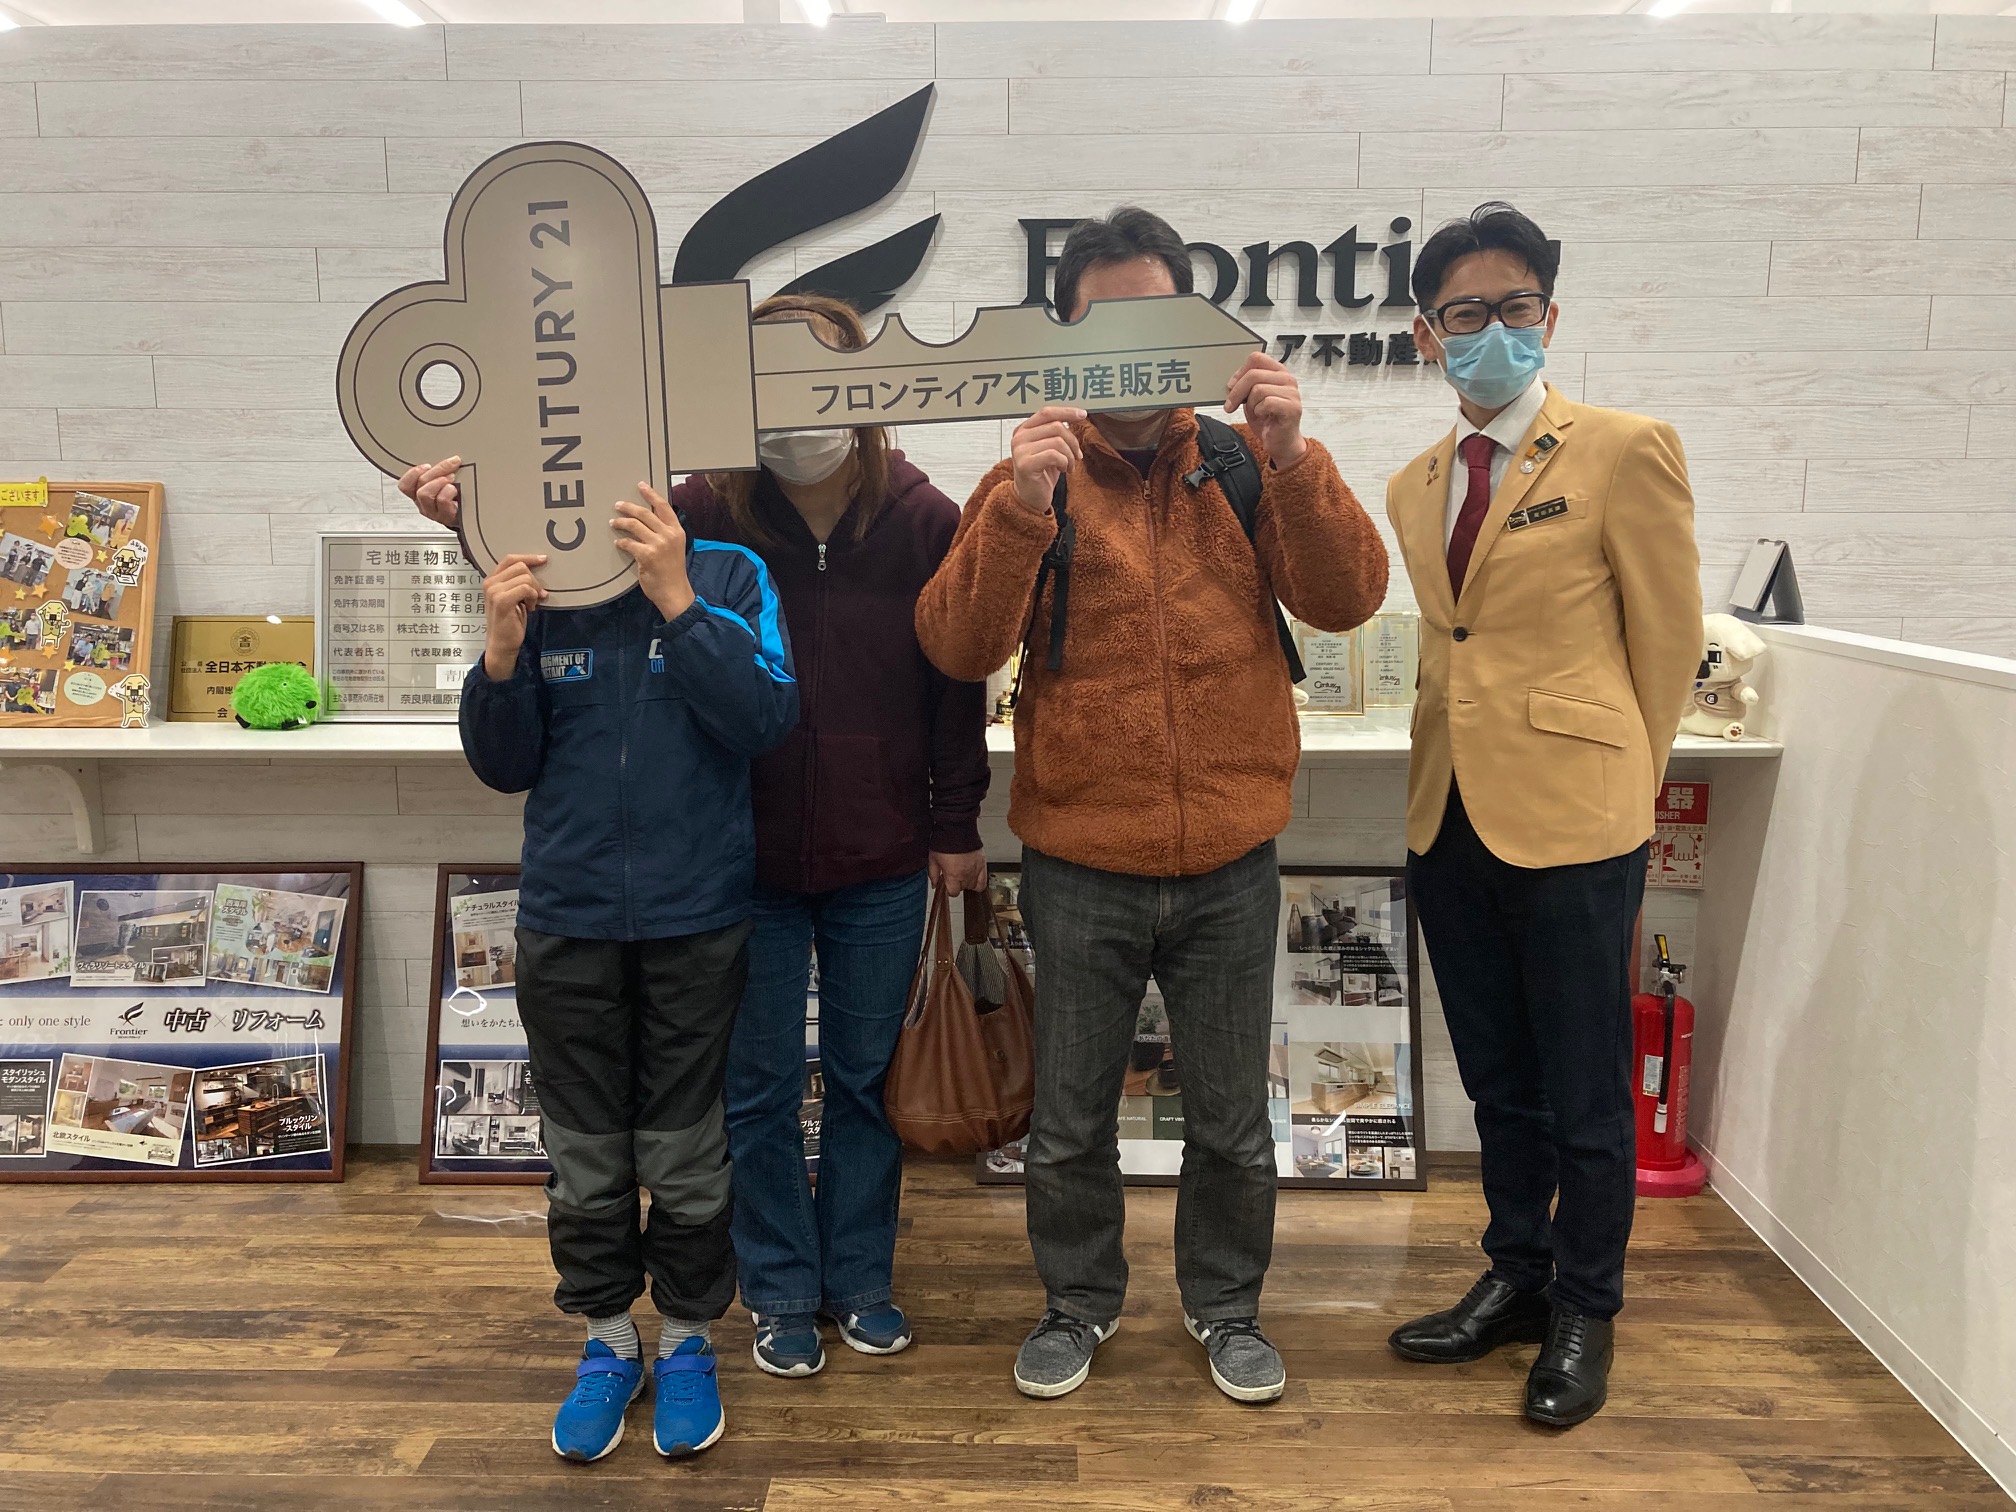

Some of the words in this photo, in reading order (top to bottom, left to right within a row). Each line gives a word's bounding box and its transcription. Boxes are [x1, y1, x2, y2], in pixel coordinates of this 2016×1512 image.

[528, 200, 571, 247] 21
[1017, 216, 1561, 308] Fonti
[1277, 330, 1440, 369] ア不動産
[811, 358, 1193, 415] フロンティア不動産販売
[531, 267, 586, 551] CENTURY
[366, 550, 473, 566] 宅地建物取
[333, 575, 385, 585] 免許証番号
[411, 592, 486, 603] 令和2年8月
[333, 598, 385, 609] 免許有効期間
[411, 603, 486, 614] 令和7年8月
[333, 623, 385, 634] 商号又は名称
[397, 623, 440, 634] 株式会社
[333, 647, 385, 657] 代表者氏名
[410, 647, 463, 657] 代表取締役
[217, 707, 228, 718] 会
[1667, 787, 1695, 810] 器
[8, 1015, 34, 1028] only
[38, 1017, 60, 1026] one
[64, 1015, 91, 1028] style
[461, 1018, 524, 1028] 想いをかたちに
[110, 1027, 148, 1035] Frontier
[2, 1068, 46, 1076] スタイリッシュ
[1, 1076, 47, 1084] モダンスタイル
[278, 1114, 318, 1126] ブルックリン
[800, 1119, 822, 1128] ブルッ
[286, 1123, 312, 1132] スタイル
